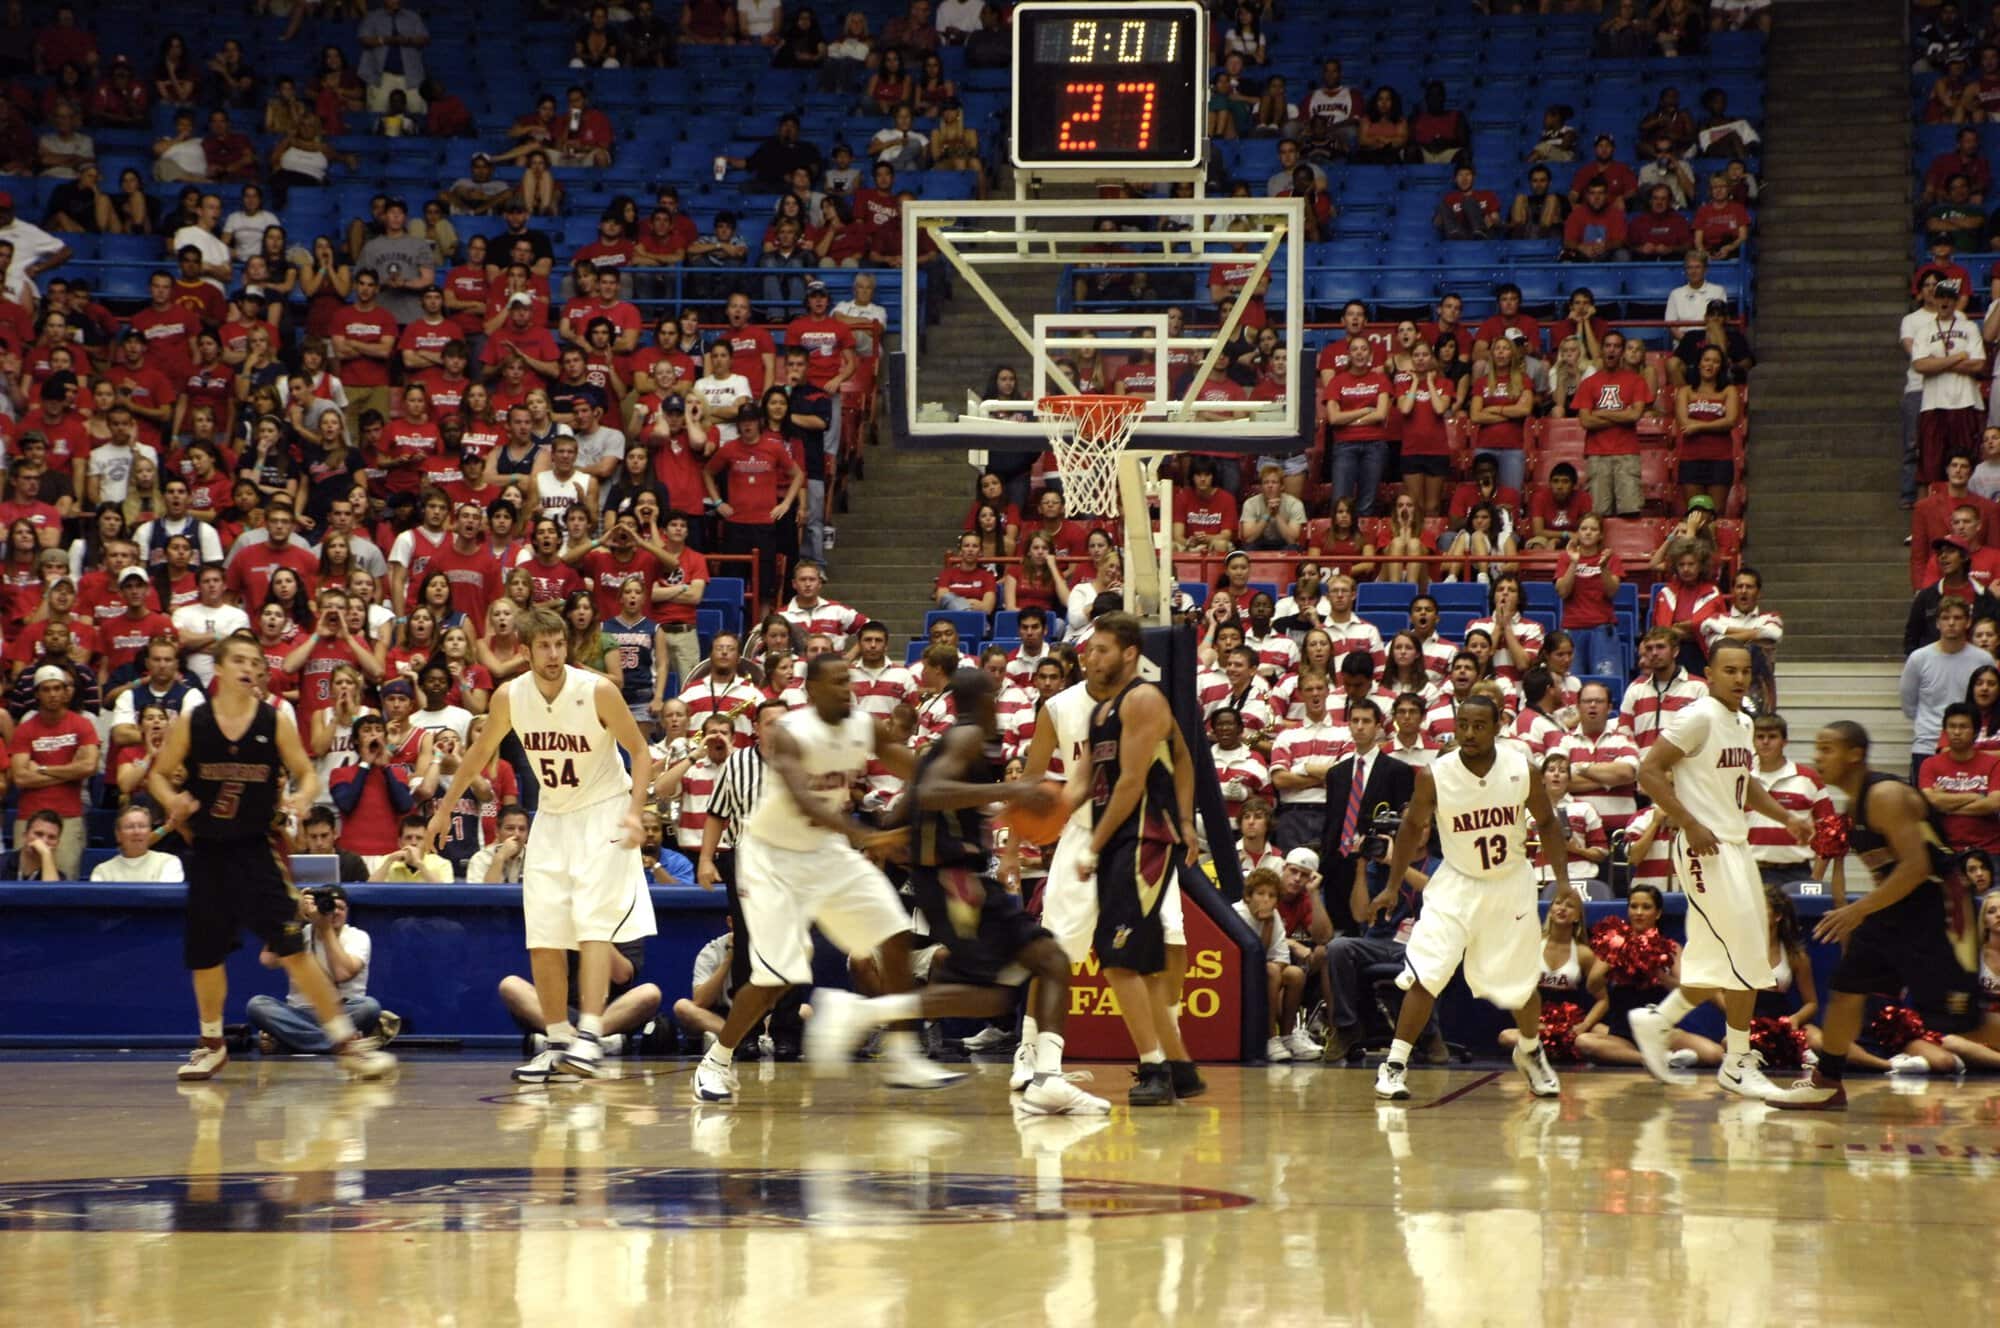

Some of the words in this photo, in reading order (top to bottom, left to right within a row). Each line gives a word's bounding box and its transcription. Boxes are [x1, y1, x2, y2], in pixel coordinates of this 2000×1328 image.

[1069, 21, 1179, 63] 9:01
[1058, 82, 1156, 151] 27
[1597, 384, 1623, 410] A
[523, 731, 592, 753] ARIZONA
[540, 758, 579, 788] 54
[209, 781, 246, 819] 5
[1735, 774, 1746, 810] 0
[1474, 834, 1508, 871] 13
[1068, 986, 1221, 1018] FAO
